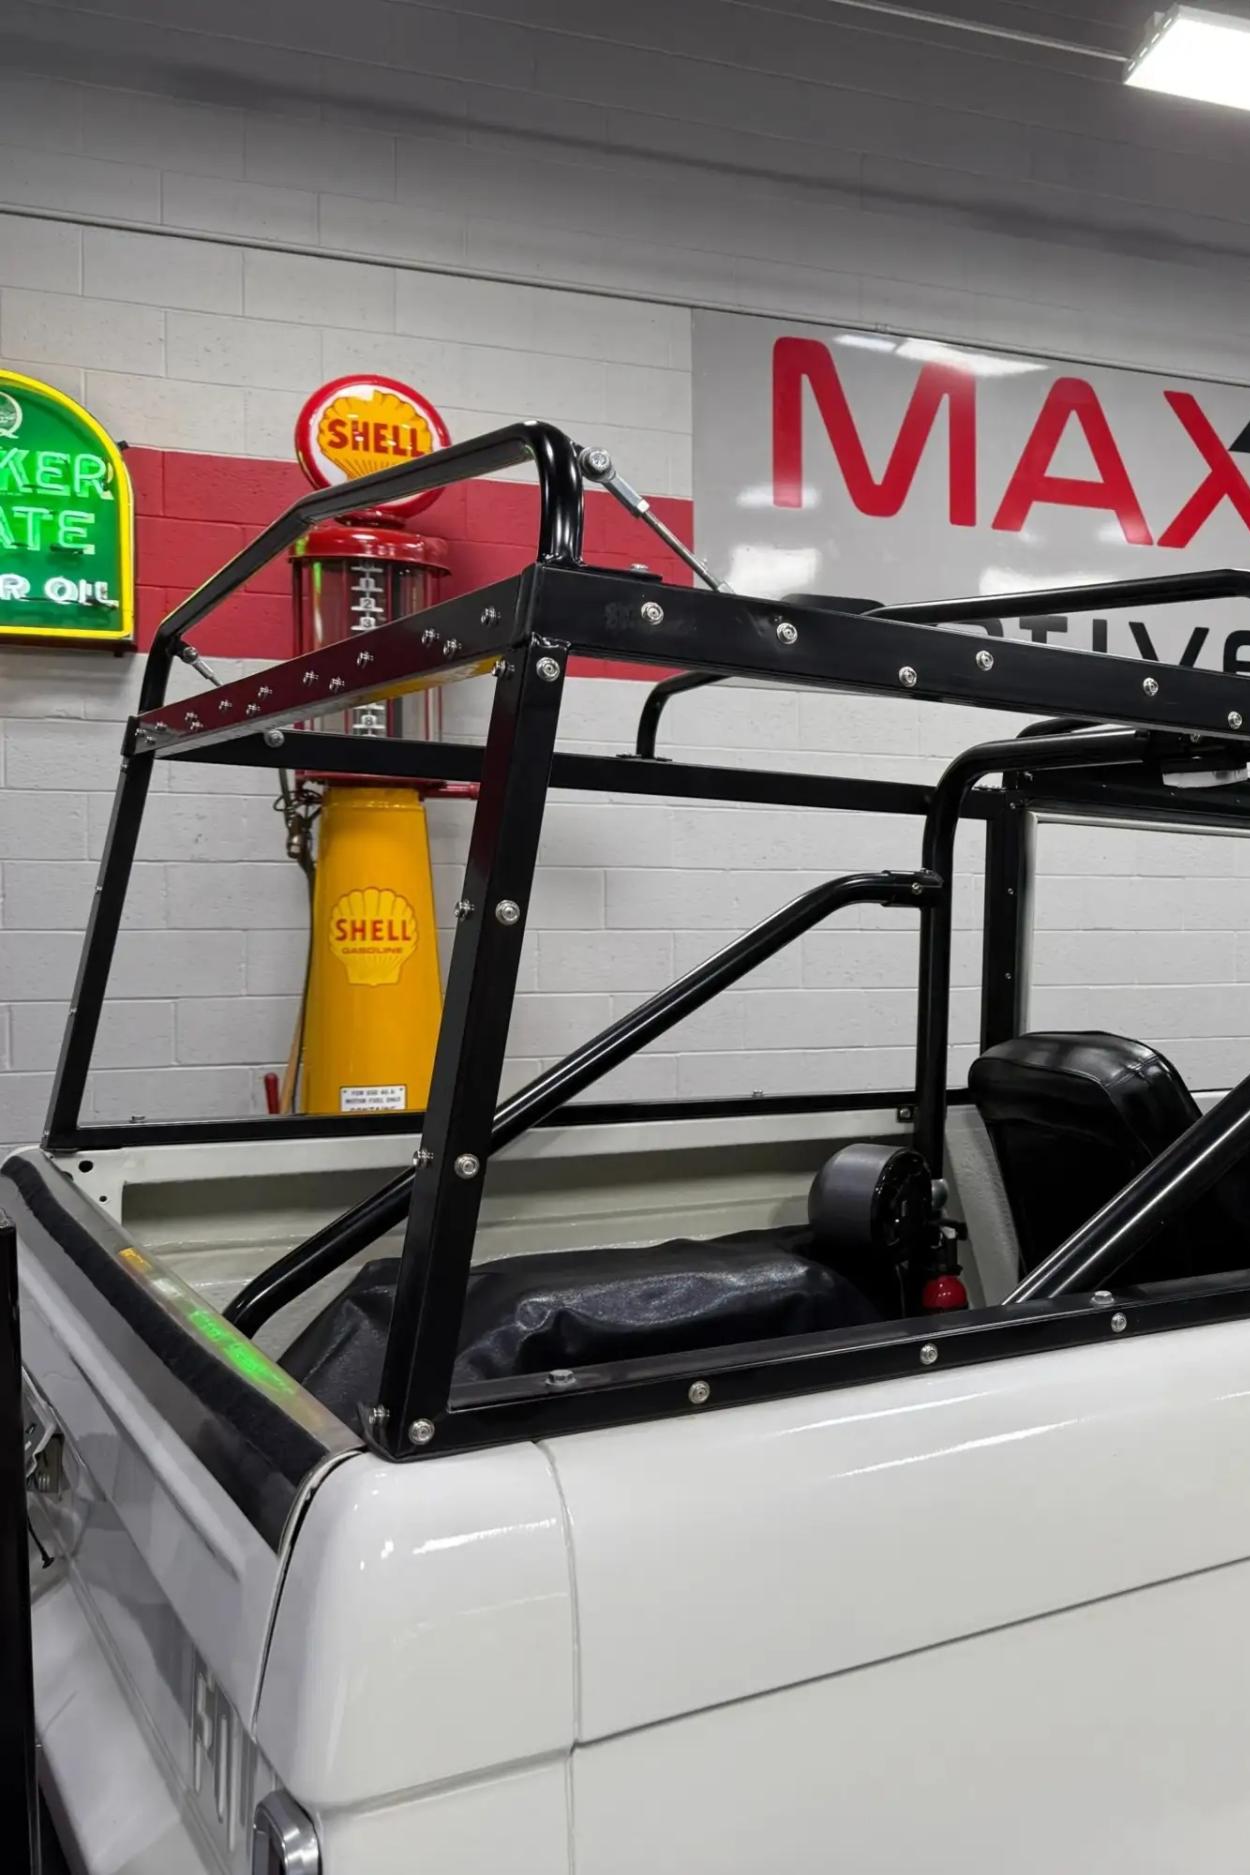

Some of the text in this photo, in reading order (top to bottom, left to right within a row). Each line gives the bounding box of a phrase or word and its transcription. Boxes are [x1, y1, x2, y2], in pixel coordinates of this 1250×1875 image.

[327, 418, 425, 458] SHELL
[44, 576, 119, 607] OIL
[335, 918, 412, 942] SHELL
